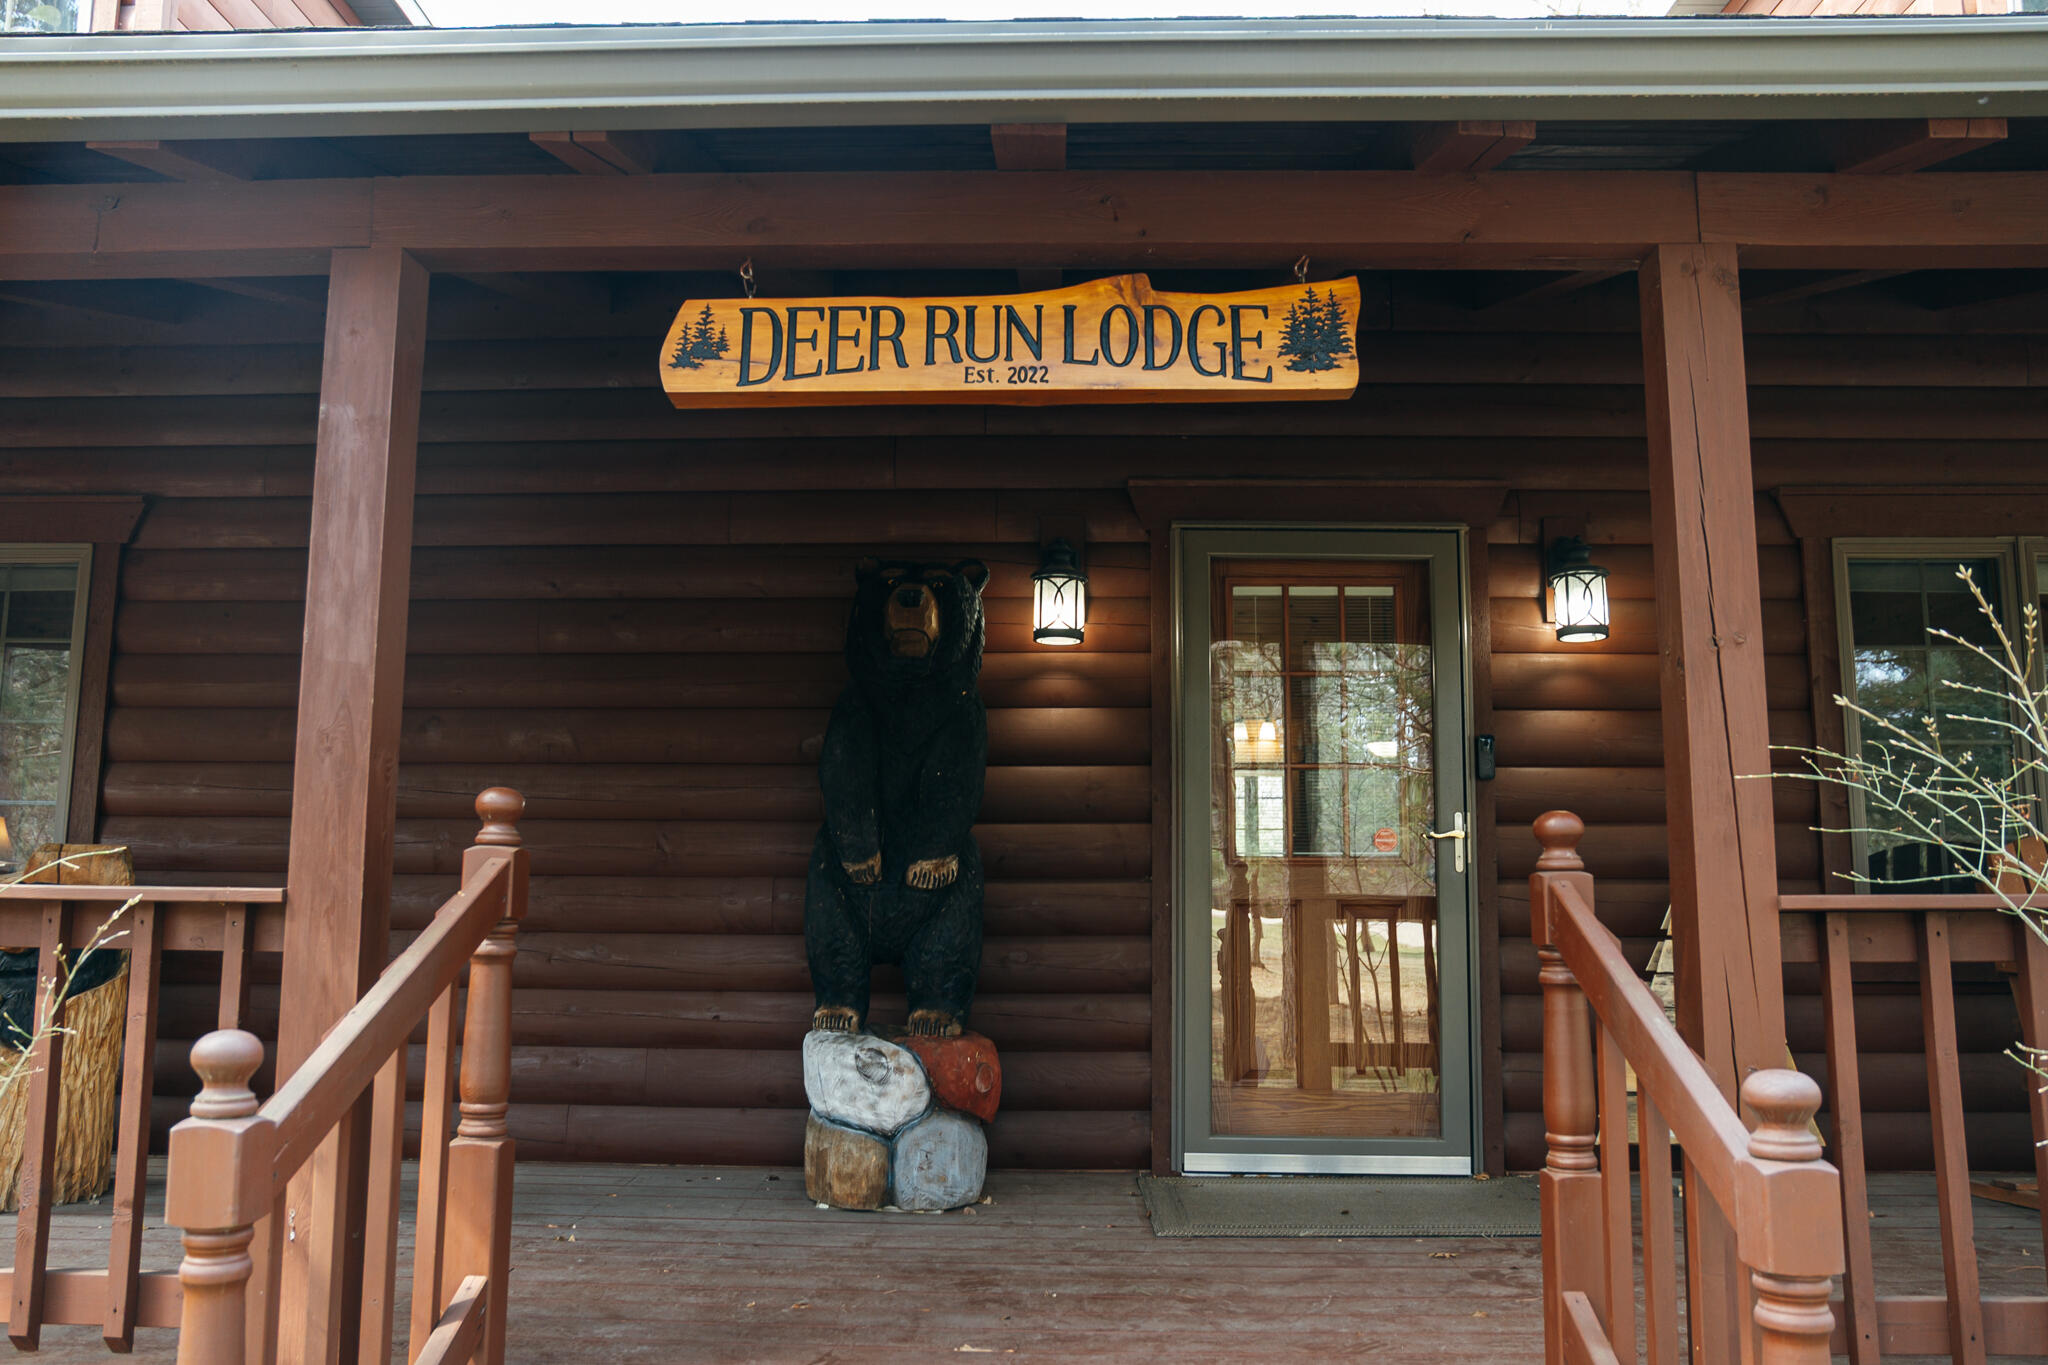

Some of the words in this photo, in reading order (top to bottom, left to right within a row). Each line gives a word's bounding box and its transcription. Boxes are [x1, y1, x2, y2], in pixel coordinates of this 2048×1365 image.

[736, 305, 909, 387] DEER
[924, 304, 1044, 366] RUN
[1062, 304, 1273, 383] LODGE
[963, 366, 1000, 384] Est.
[1007, 365, 1049, 384] 2022
